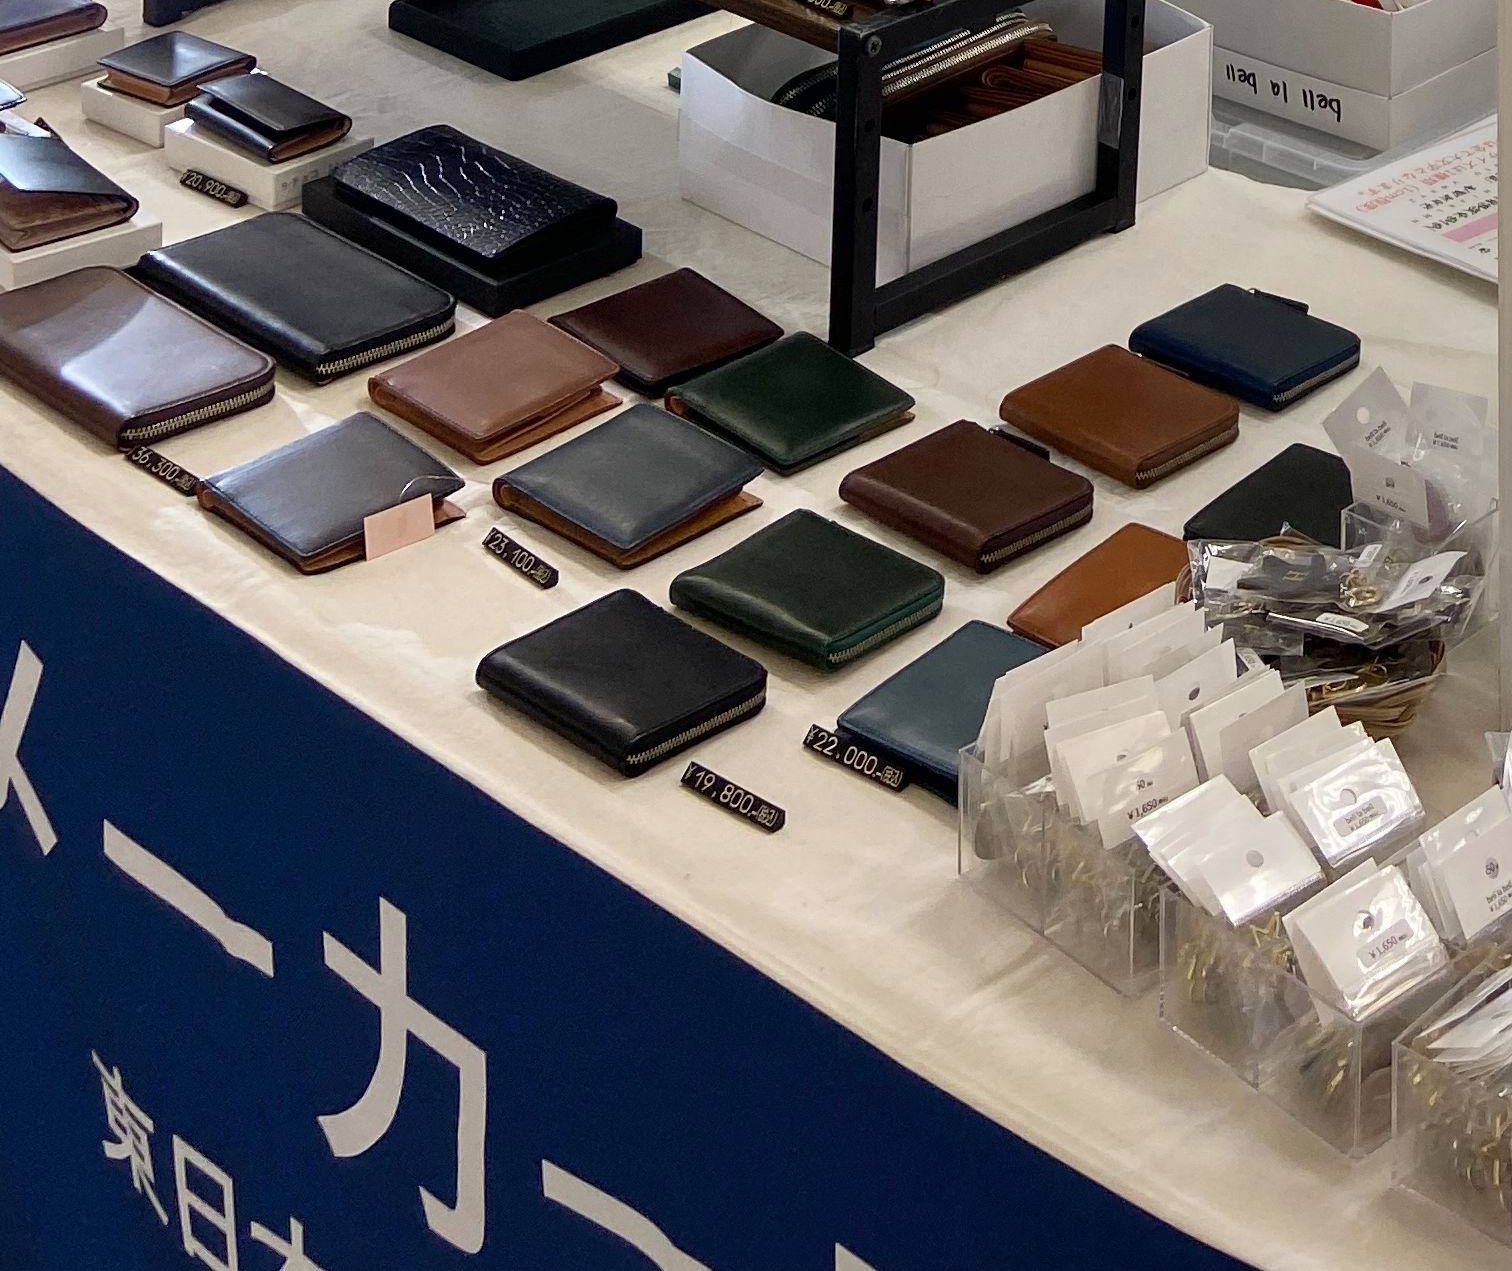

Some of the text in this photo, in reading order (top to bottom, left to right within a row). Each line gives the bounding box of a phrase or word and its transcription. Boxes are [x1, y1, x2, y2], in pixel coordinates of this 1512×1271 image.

[1225, 63, 1342, 123] bell la bell
